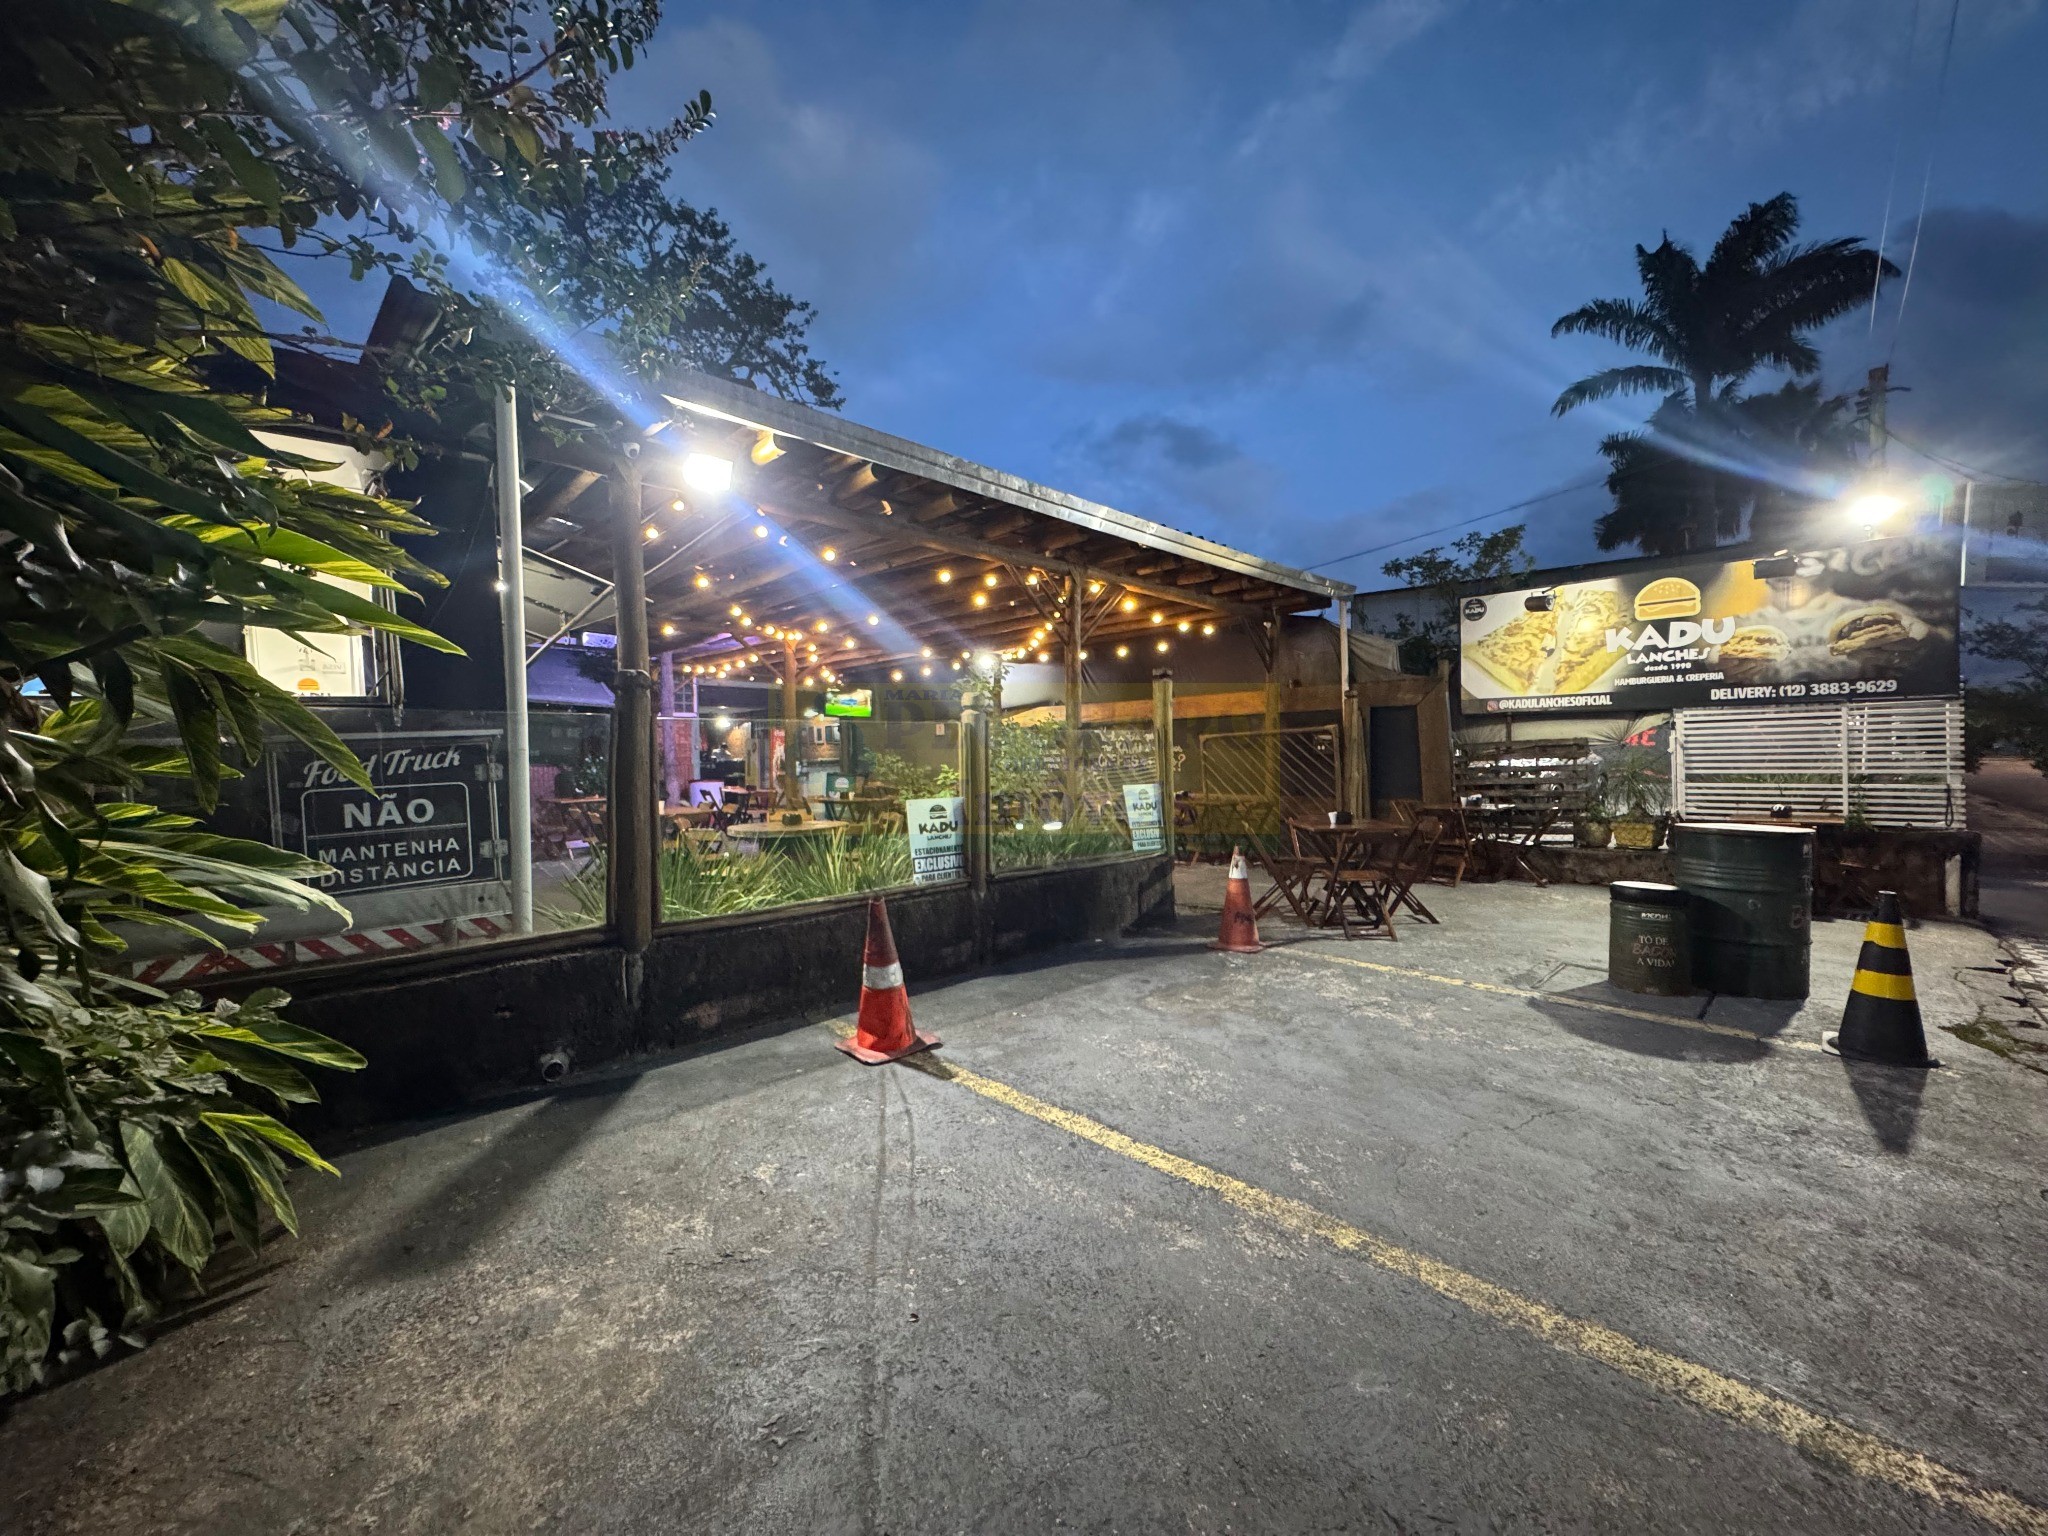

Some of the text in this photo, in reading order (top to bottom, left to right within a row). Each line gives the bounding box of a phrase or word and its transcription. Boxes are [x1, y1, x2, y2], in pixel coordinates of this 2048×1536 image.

[1605, 615, 1735, 653] KADU
[1626, 646, 1711, 665] LANCHES
[1644, 664, 1669, 672] desde
[1614, 671, 1725, 687] HAMBURGUERIA & CREPERIA
[1710, 680, 1897, 701] DELIVERY: (12) 3883-9629
[1499, 694, 1613, 710] @KADULANCHESOFICIAL
[383, 746, 461, 776] Truck
[343, 793, 435, 829] NÃO
[1132, 801, 1157, 812] KADU
[918, 820, 959, 835] KADU
[318, 838, 460, 864] MANTENHA
[320, 857, 462, 888] DISTÂNCIA
